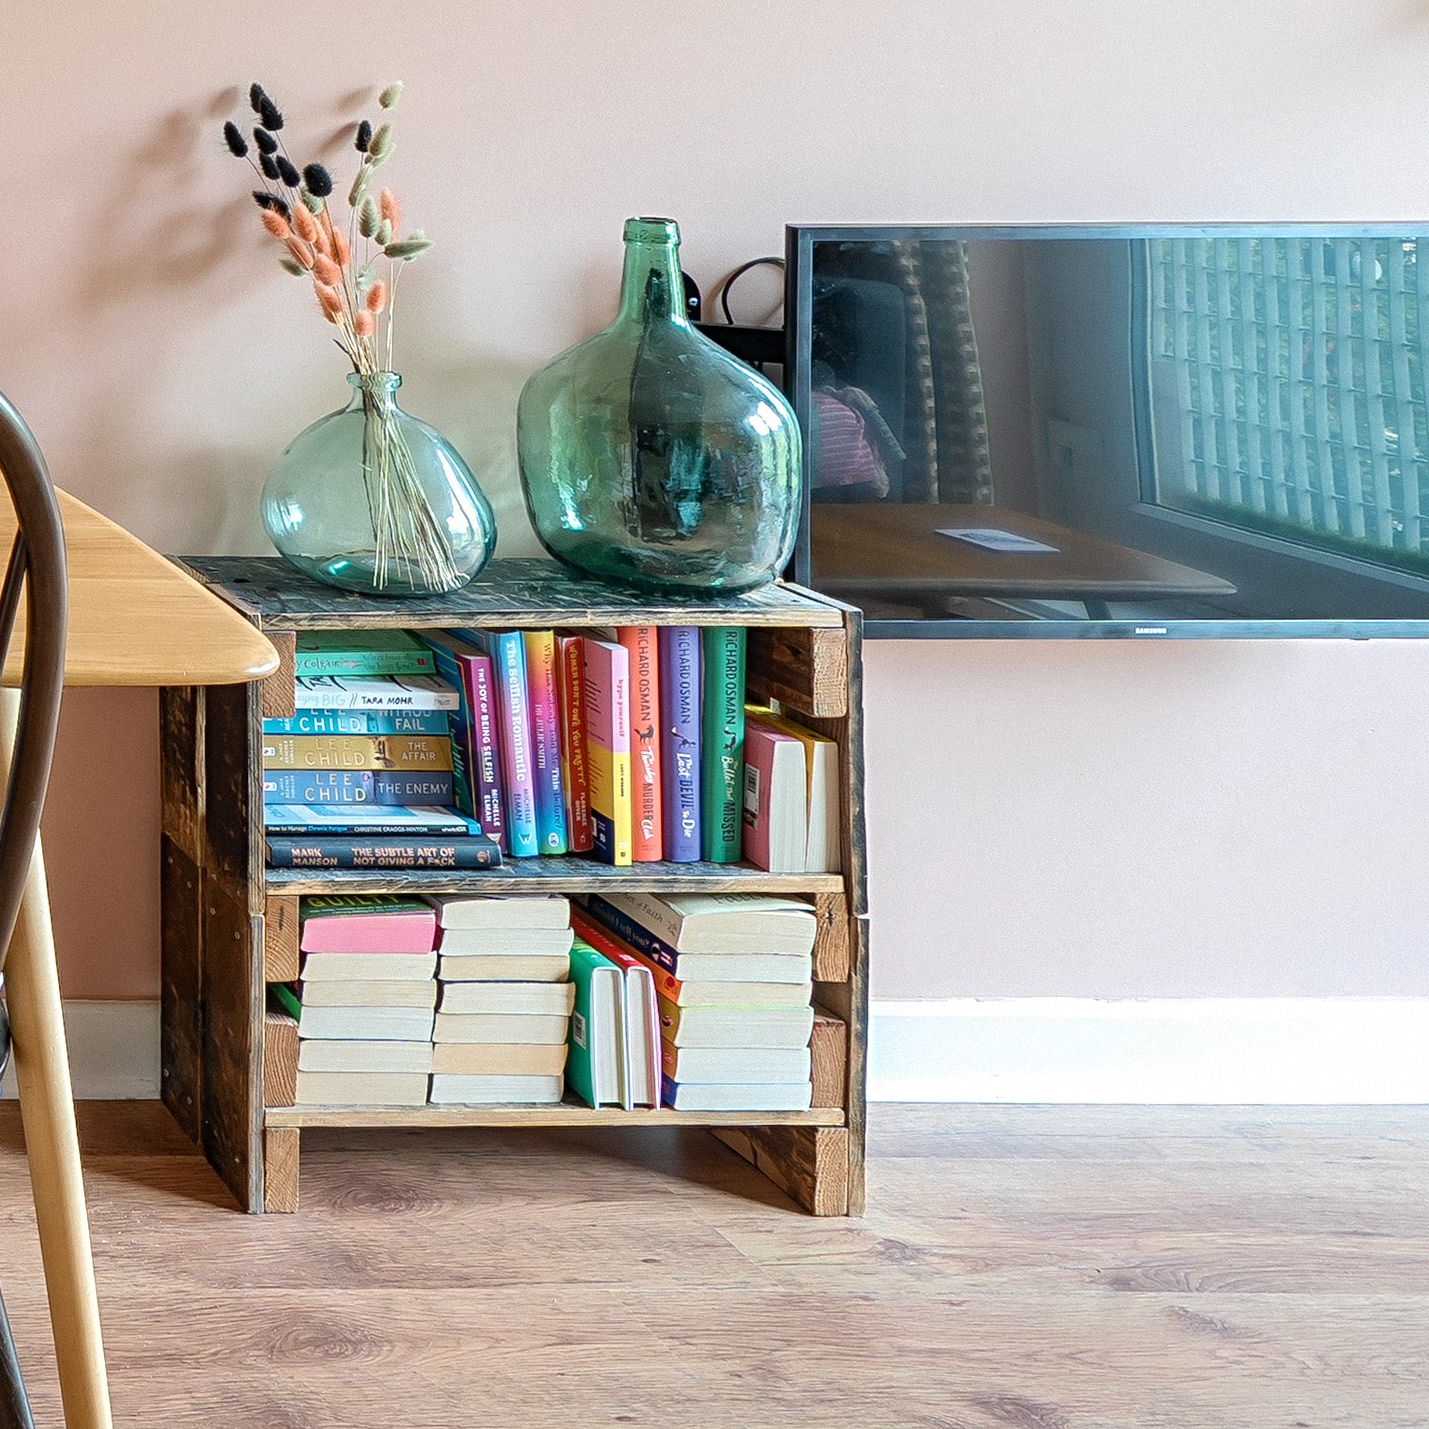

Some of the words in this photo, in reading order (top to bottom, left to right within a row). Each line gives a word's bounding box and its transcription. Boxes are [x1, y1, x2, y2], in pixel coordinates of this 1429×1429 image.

[505, 640, 517, 667] The
[569, 645, 579, 678] WOMEN
[477, 668, 486, 683] THE
[322, 694, 346, 706] BIG
[361, 696, 383, 705] TARA
[386, 696, 413, 705] MOHR
[478, 683, 488, 702] JOY
[509, 668, 521, 715] Selfish
[639, 679, 651, 721] OSMAN
[680, 681, 691, 724] OSMAN
[480, 702, 488, 714] OF
[725, 682, 737, 725] OSMAN
[299, 717, 362, 732] CHILD
[395, 718, 426, 731] FAIL
[481, 714, 491, 744] BEING
[536, 718, 544, 741] JULIE
[315, 738, 353, 750] LEE
[408, 741, 428, 751] THE
[512, 715, 527, 782] Romantic
[572, 729, 581, 746] YOU
[304, 751, 366, 767] CHILD
[401, 751, 437, 761] AFFAIR
[484, 745, 494, 783] SELFISH
[538, 742, 546, 769] SMITH
[677, 753, 691, 779] Last
[315, 773, 353, 786] LEE
[551, 767, 560, 790] This
[722, 755, 736, 785] Bullet
[304, 787, 367, 802] CHILD
[378, 783, 402, 794] THE
[405, 783, 449, 795] ENEMY
[679, 779, 694, 810] DEVIL
[483, 794, 492, 823] ELMAN
[491, 788, 501, 827] MICHELLE
[513, 793, 523, 821] ELMAN
[642, 783, 654, 820] MURDER
[641, 819, 654, 840] Club
[682, 819, 696, 838] Die
[721, 801, 736, 843] MISSED
[291, 848, 322, 858] MARK
[292, 858, 338, 867] MANSON
[351, 848, 373, 858] THE
[374, 848, 415, 858] SUBTLE
[417, 848, 438, 858] ART
[440, 848, 455, 858] OF
[353, 858, 375, 867] NOT
[377, 858, 414, 867] GIVING
[416, 858, 425, 867] A
